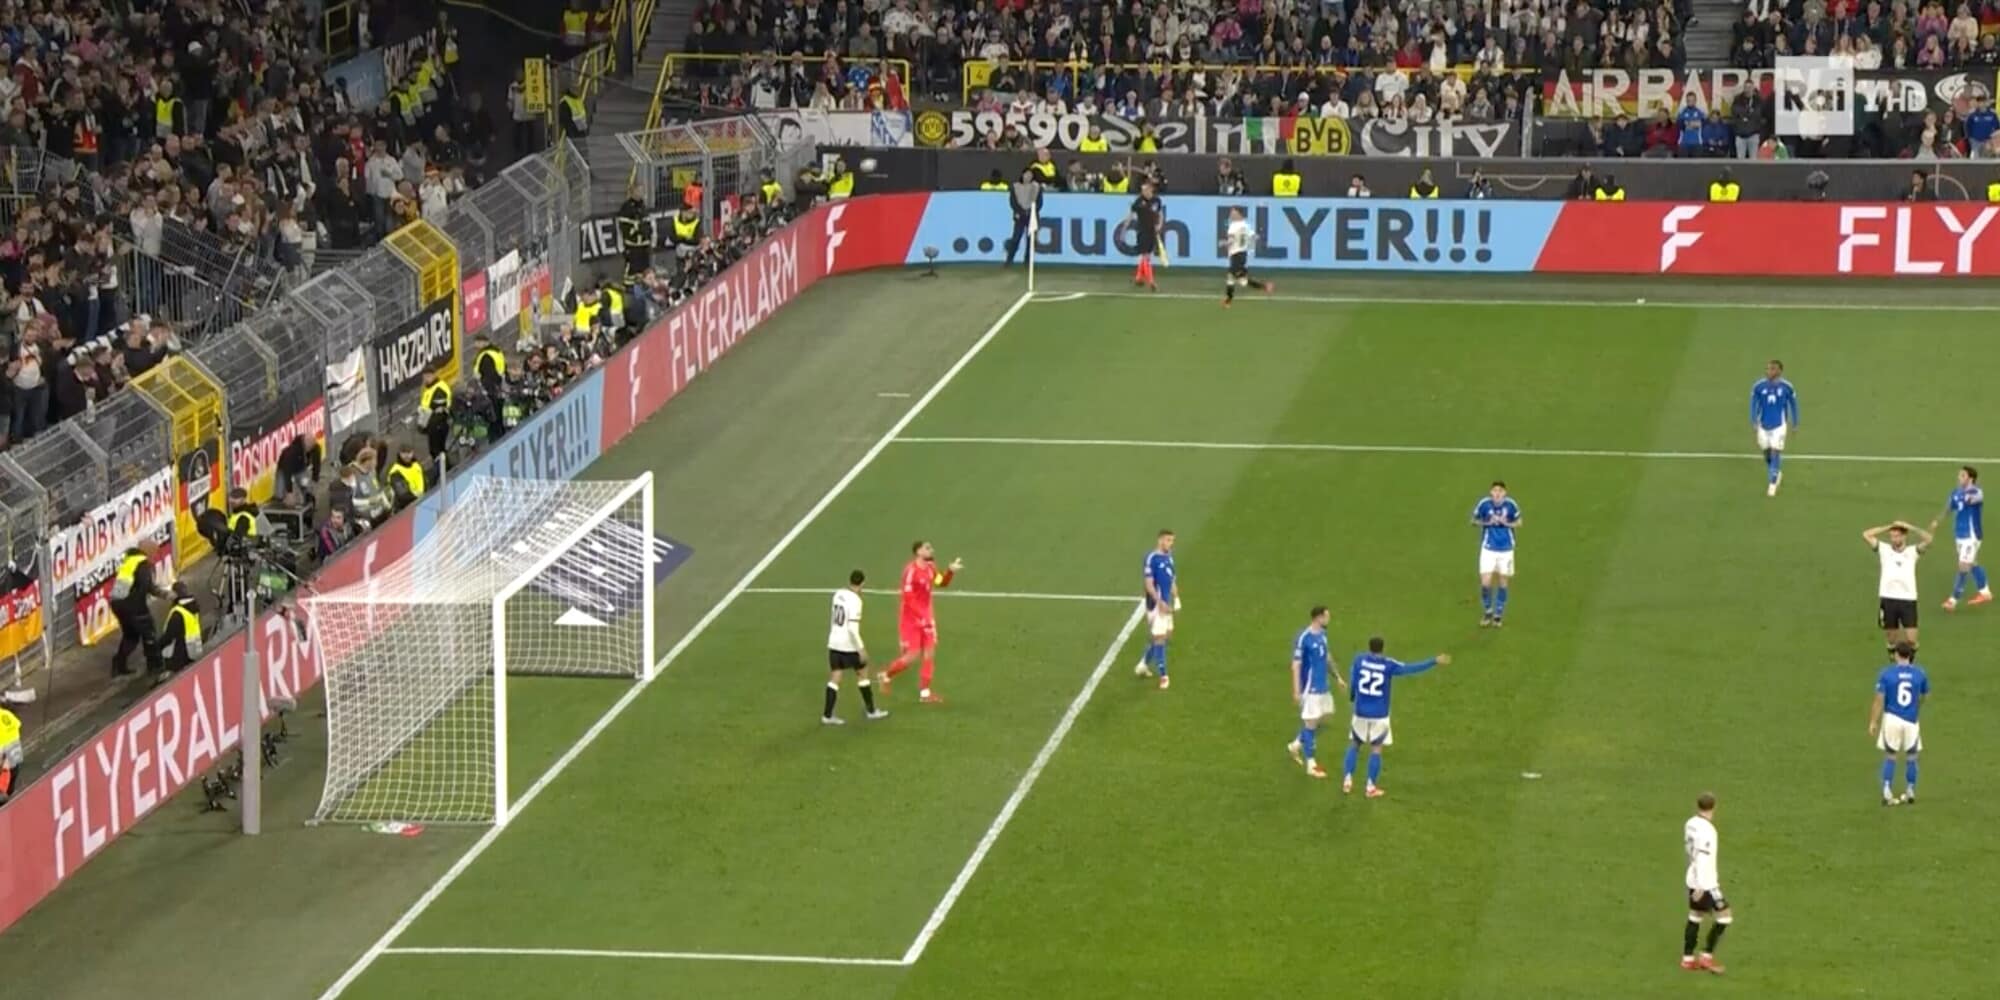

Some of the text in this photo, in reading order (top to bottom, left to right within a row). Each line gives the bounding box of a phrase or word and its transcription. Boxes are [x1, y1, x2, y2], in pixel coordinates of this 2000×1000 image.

[1296, 116, 1344, 154] BVB
[1360, 115, 1510, 159] City
[1216, 205, 1494, 263] FLYER!!!
[1837, 206, 2000, 273] FLY
[669, 231, 799, 393] FLYERALARM
[379, 309, 451, 393] HARZBURG
[53, 511, 118, 581] GLAUBT
[1358, 668, 1385, 697] 22
[1897, 681, 1913, 708] 6
